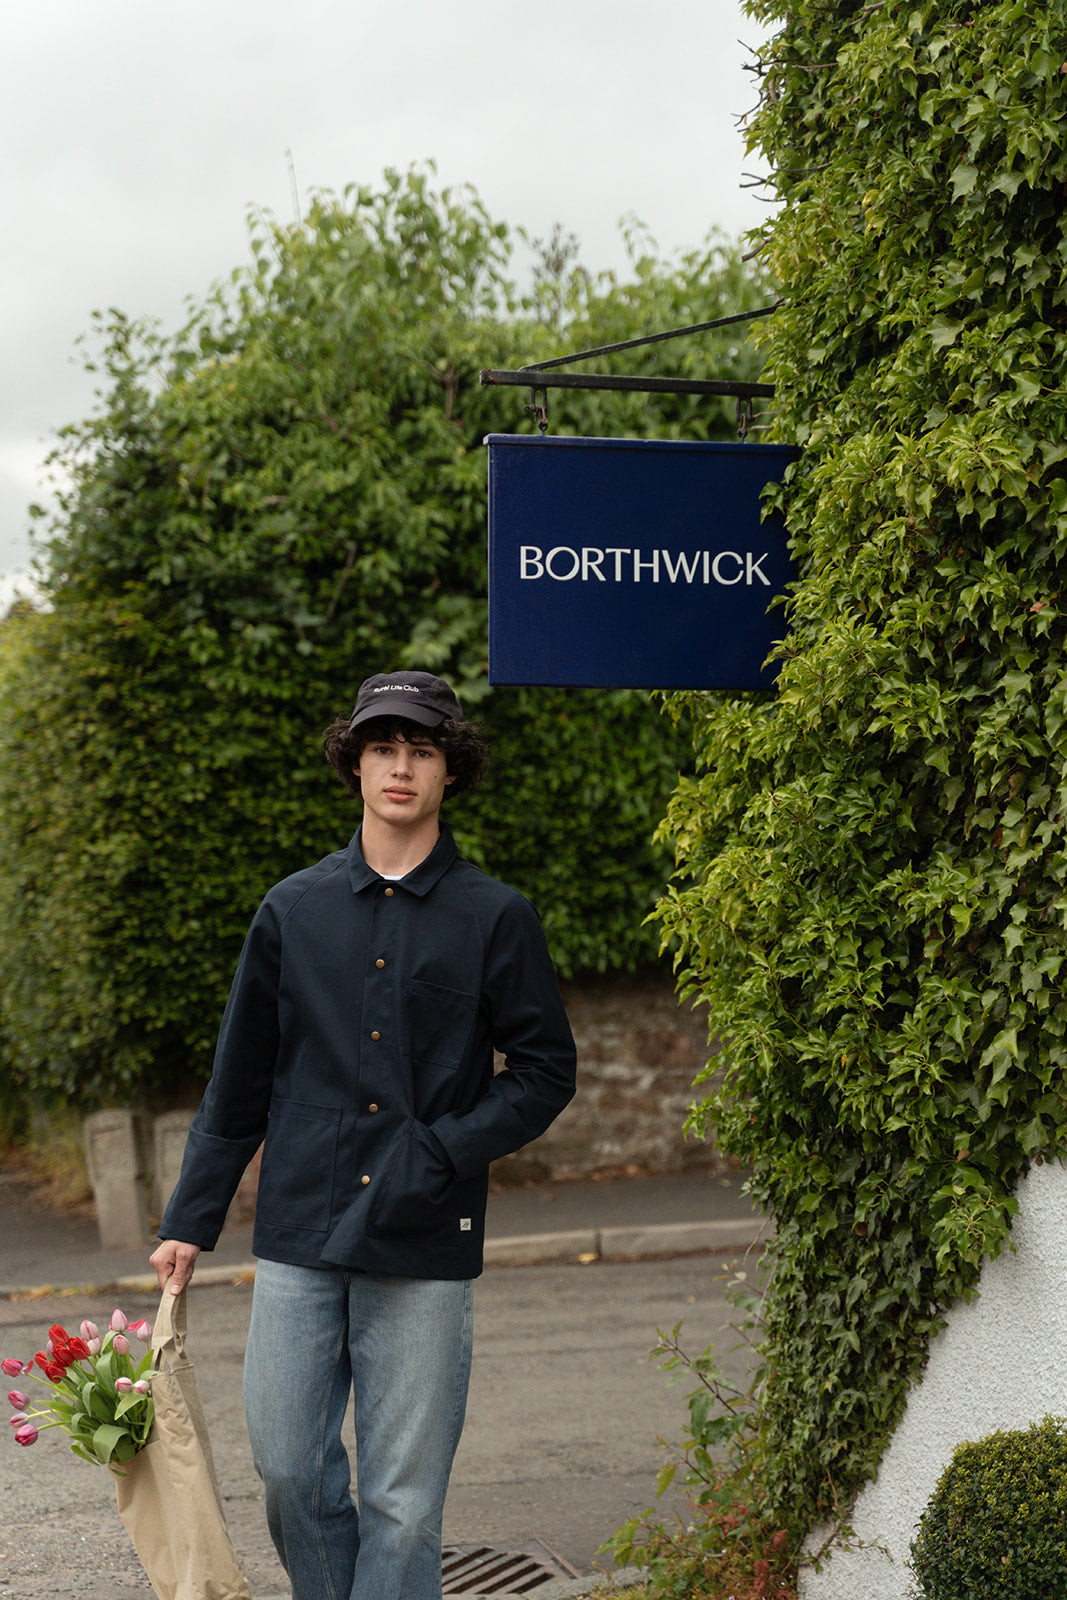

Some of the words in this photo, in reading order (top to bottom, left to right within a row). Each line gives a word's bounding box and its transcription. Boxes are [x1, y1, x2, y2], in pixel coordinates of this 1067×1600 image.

[519, 545, 772, 586] BORTHWICK
[373, 684, 390, 693] Rural
[403, 684, 419, 693] Club
